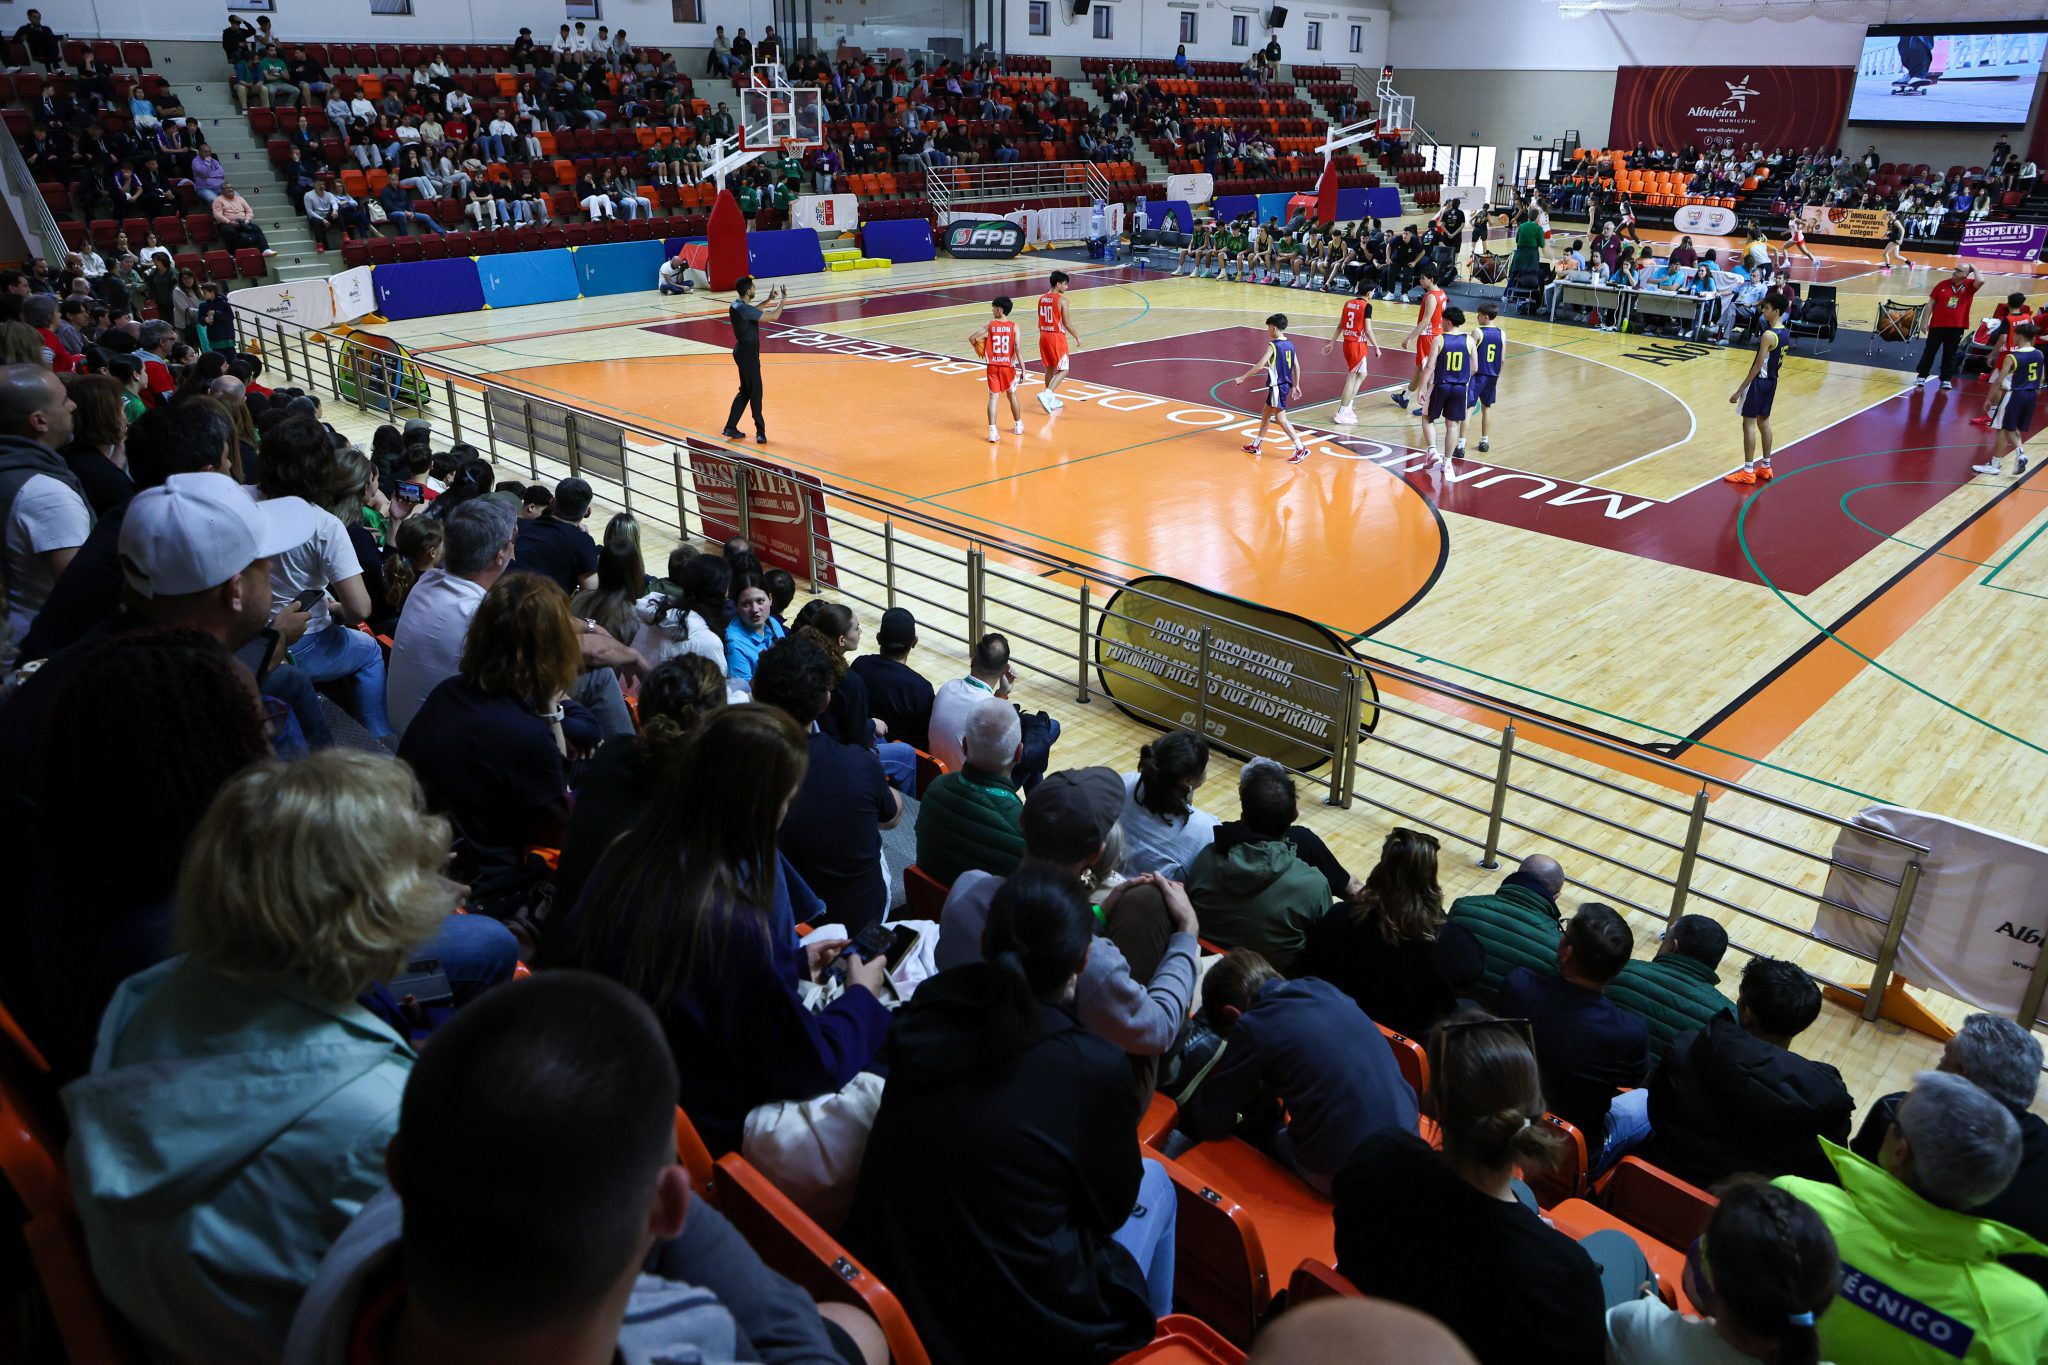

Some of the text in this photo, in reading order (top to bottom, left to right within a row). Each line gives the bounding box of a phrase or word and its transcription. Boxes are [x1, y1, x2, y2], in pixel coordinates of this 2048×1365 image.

[1687, 106, 1737, 119] Albufeira
[970, 230, 1017, 246] FPB
[1964, 225, 2028, 237] RESPEITA
[1040, 305, 1054, 324] 40
[1346, 311, 1355, 329] 3
[992, 335, 1010, 354] 28
[1486, 343, 1496, 363] 6
[1285, 350, 1292, 369] 4
[1446, 351, 1463, 372] 10
[2028, 362, 2038, 382] 5
[1149, 617, 1185, 646] PAIS
[1105, 638, 1168, 677] FORMAM
[1220, 678, 1253, 706] QUE
[1249, 689, 1330, 738] INSPIRAM.
